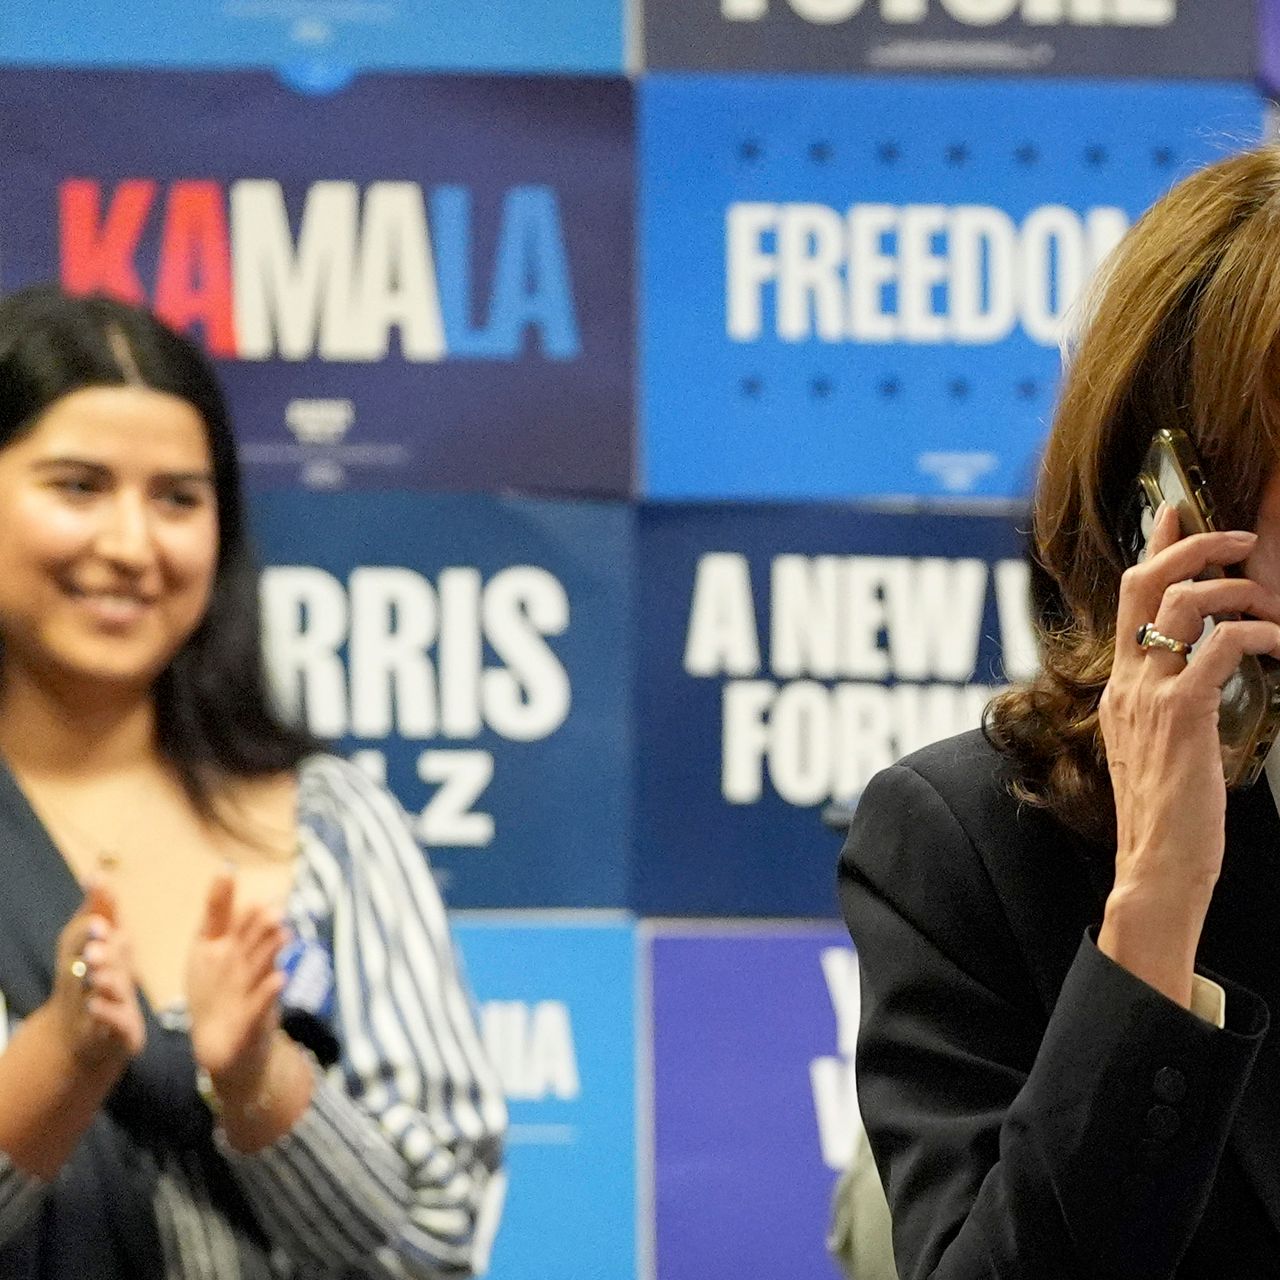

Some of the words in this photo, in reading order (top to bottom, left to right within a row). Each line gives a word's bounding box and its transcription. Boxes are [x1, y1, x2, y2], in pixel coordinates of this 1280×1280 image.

[58, 178, 582, 362] KAMALA
[684, 552, 760, 677] A
[770, 555, 985, 681] NEW
